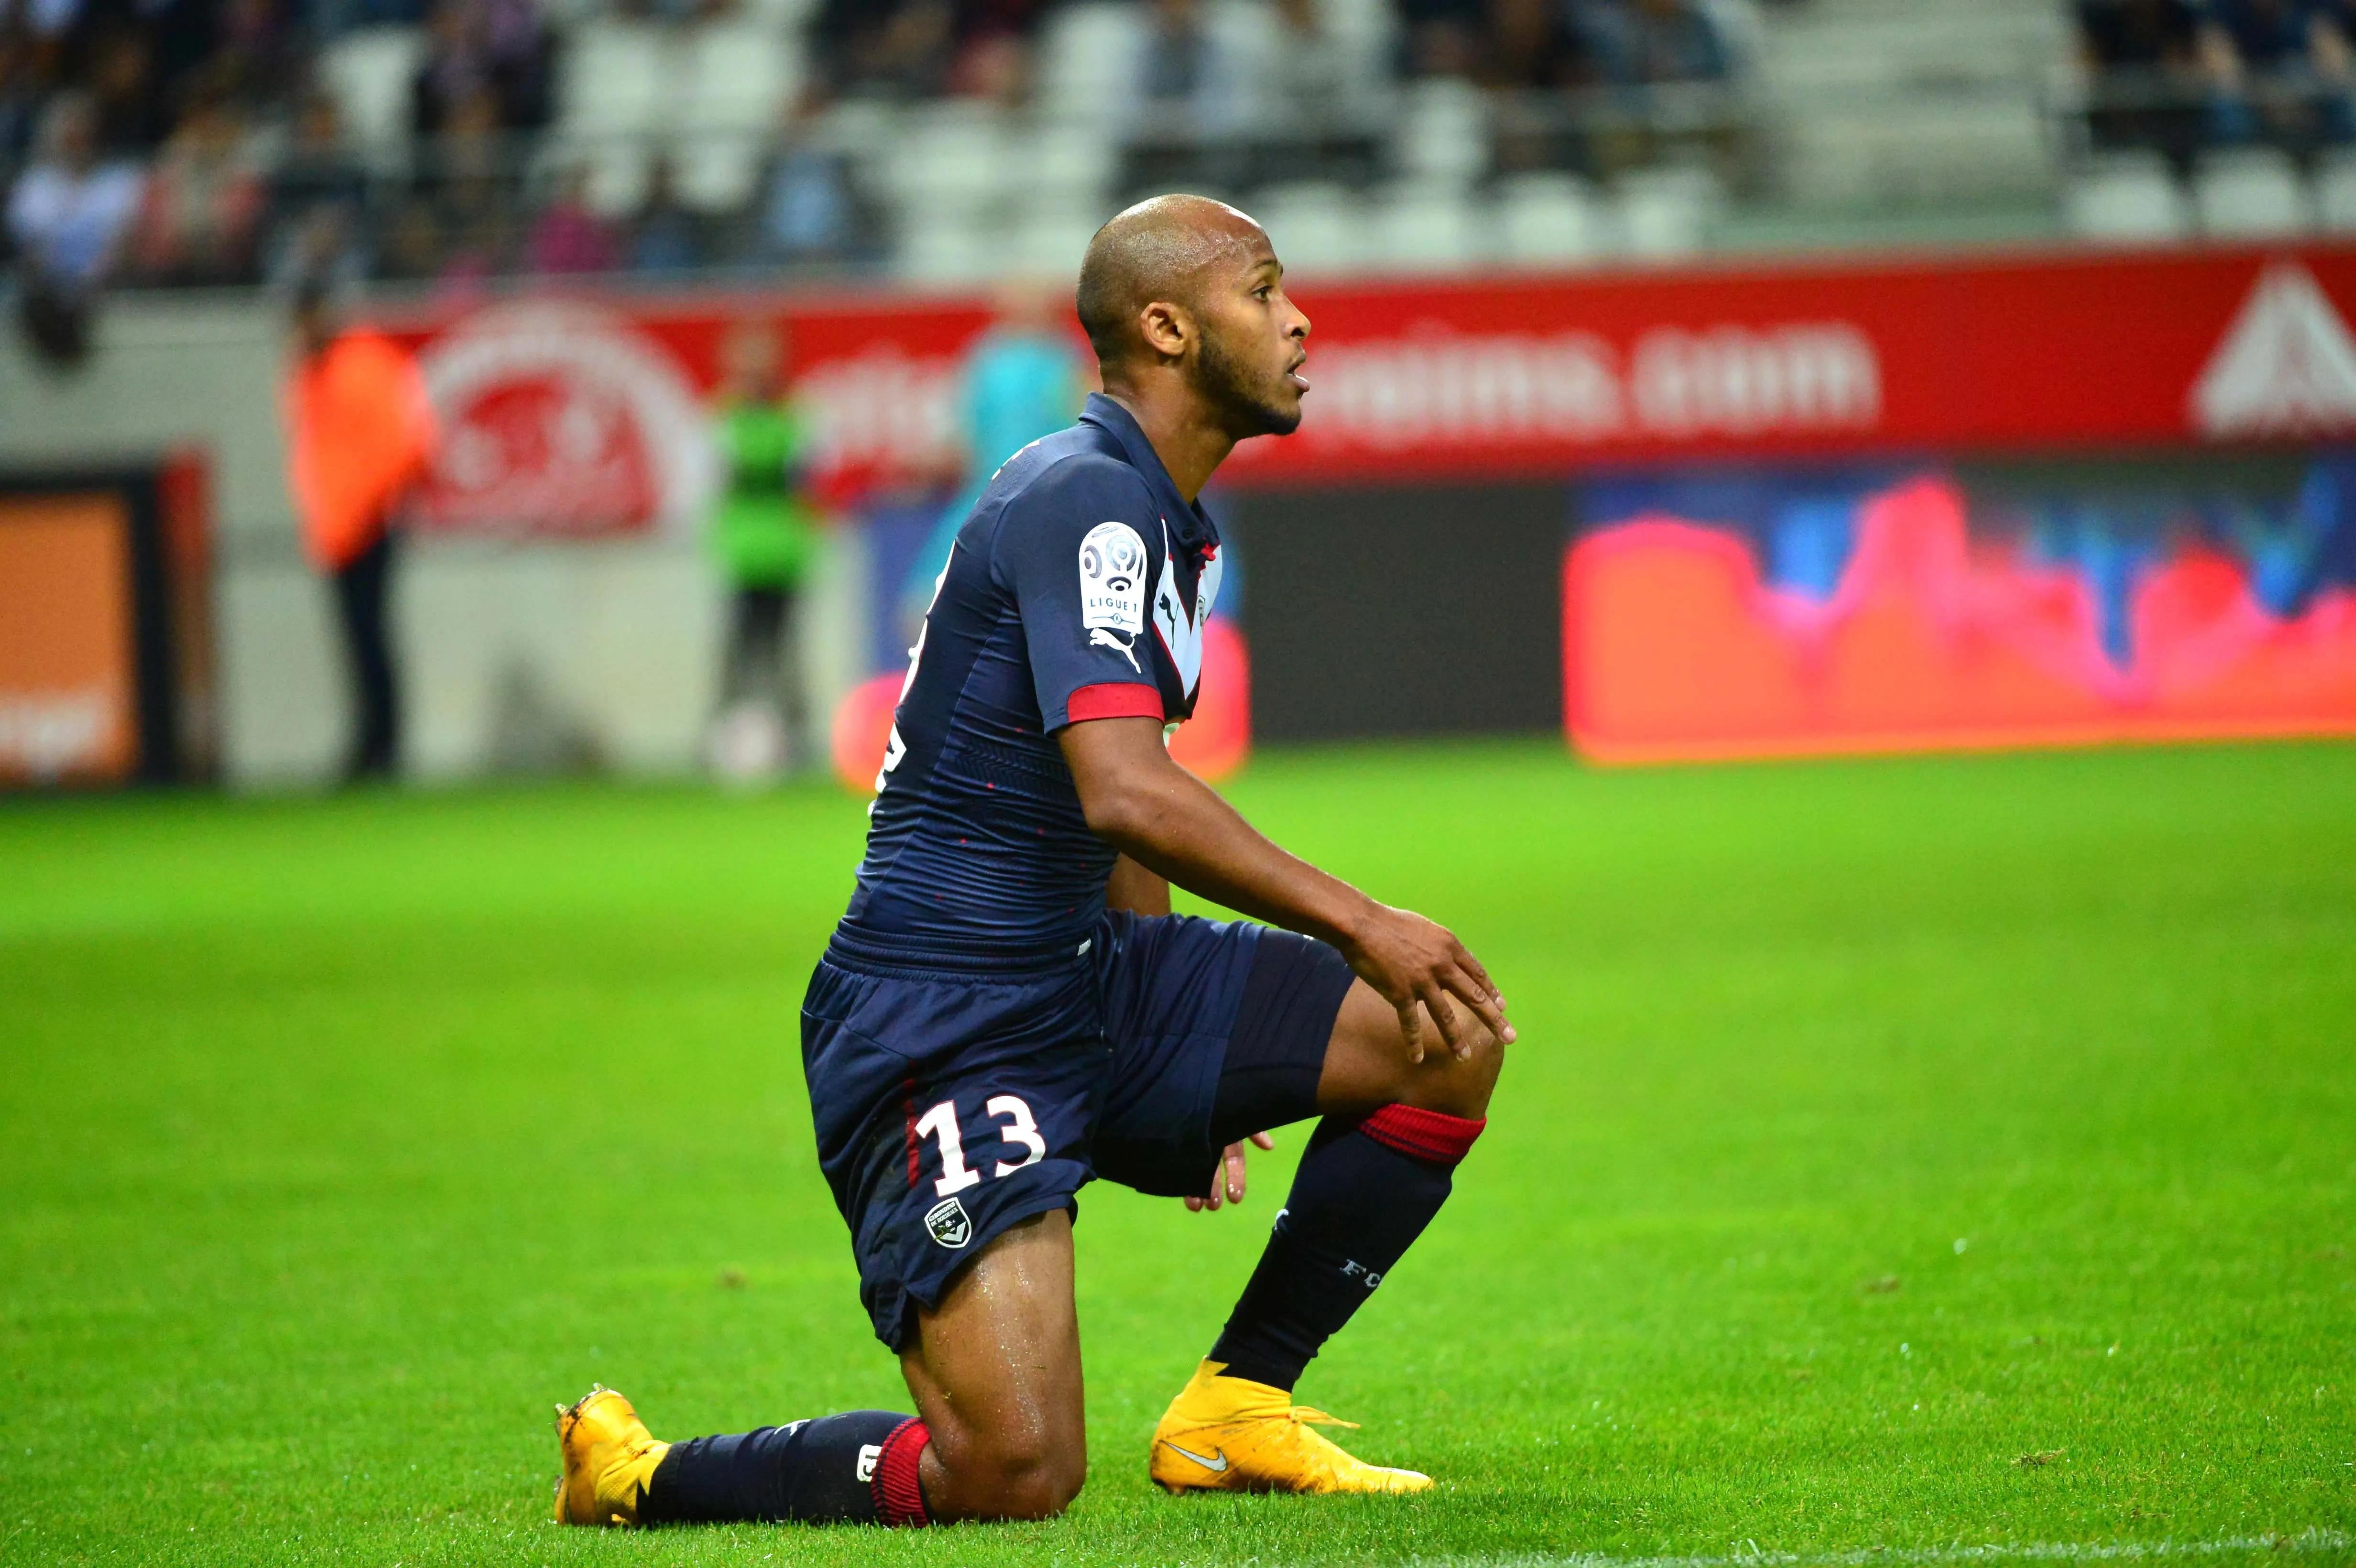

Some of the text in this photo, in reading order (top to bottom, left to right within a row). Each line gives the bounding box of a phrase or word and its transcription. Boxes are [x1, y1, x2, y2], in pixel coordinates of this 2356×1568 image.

[1090, 598, 1136, 612] LIGUE 1
[915, 1095, 1047, 1197] 13
